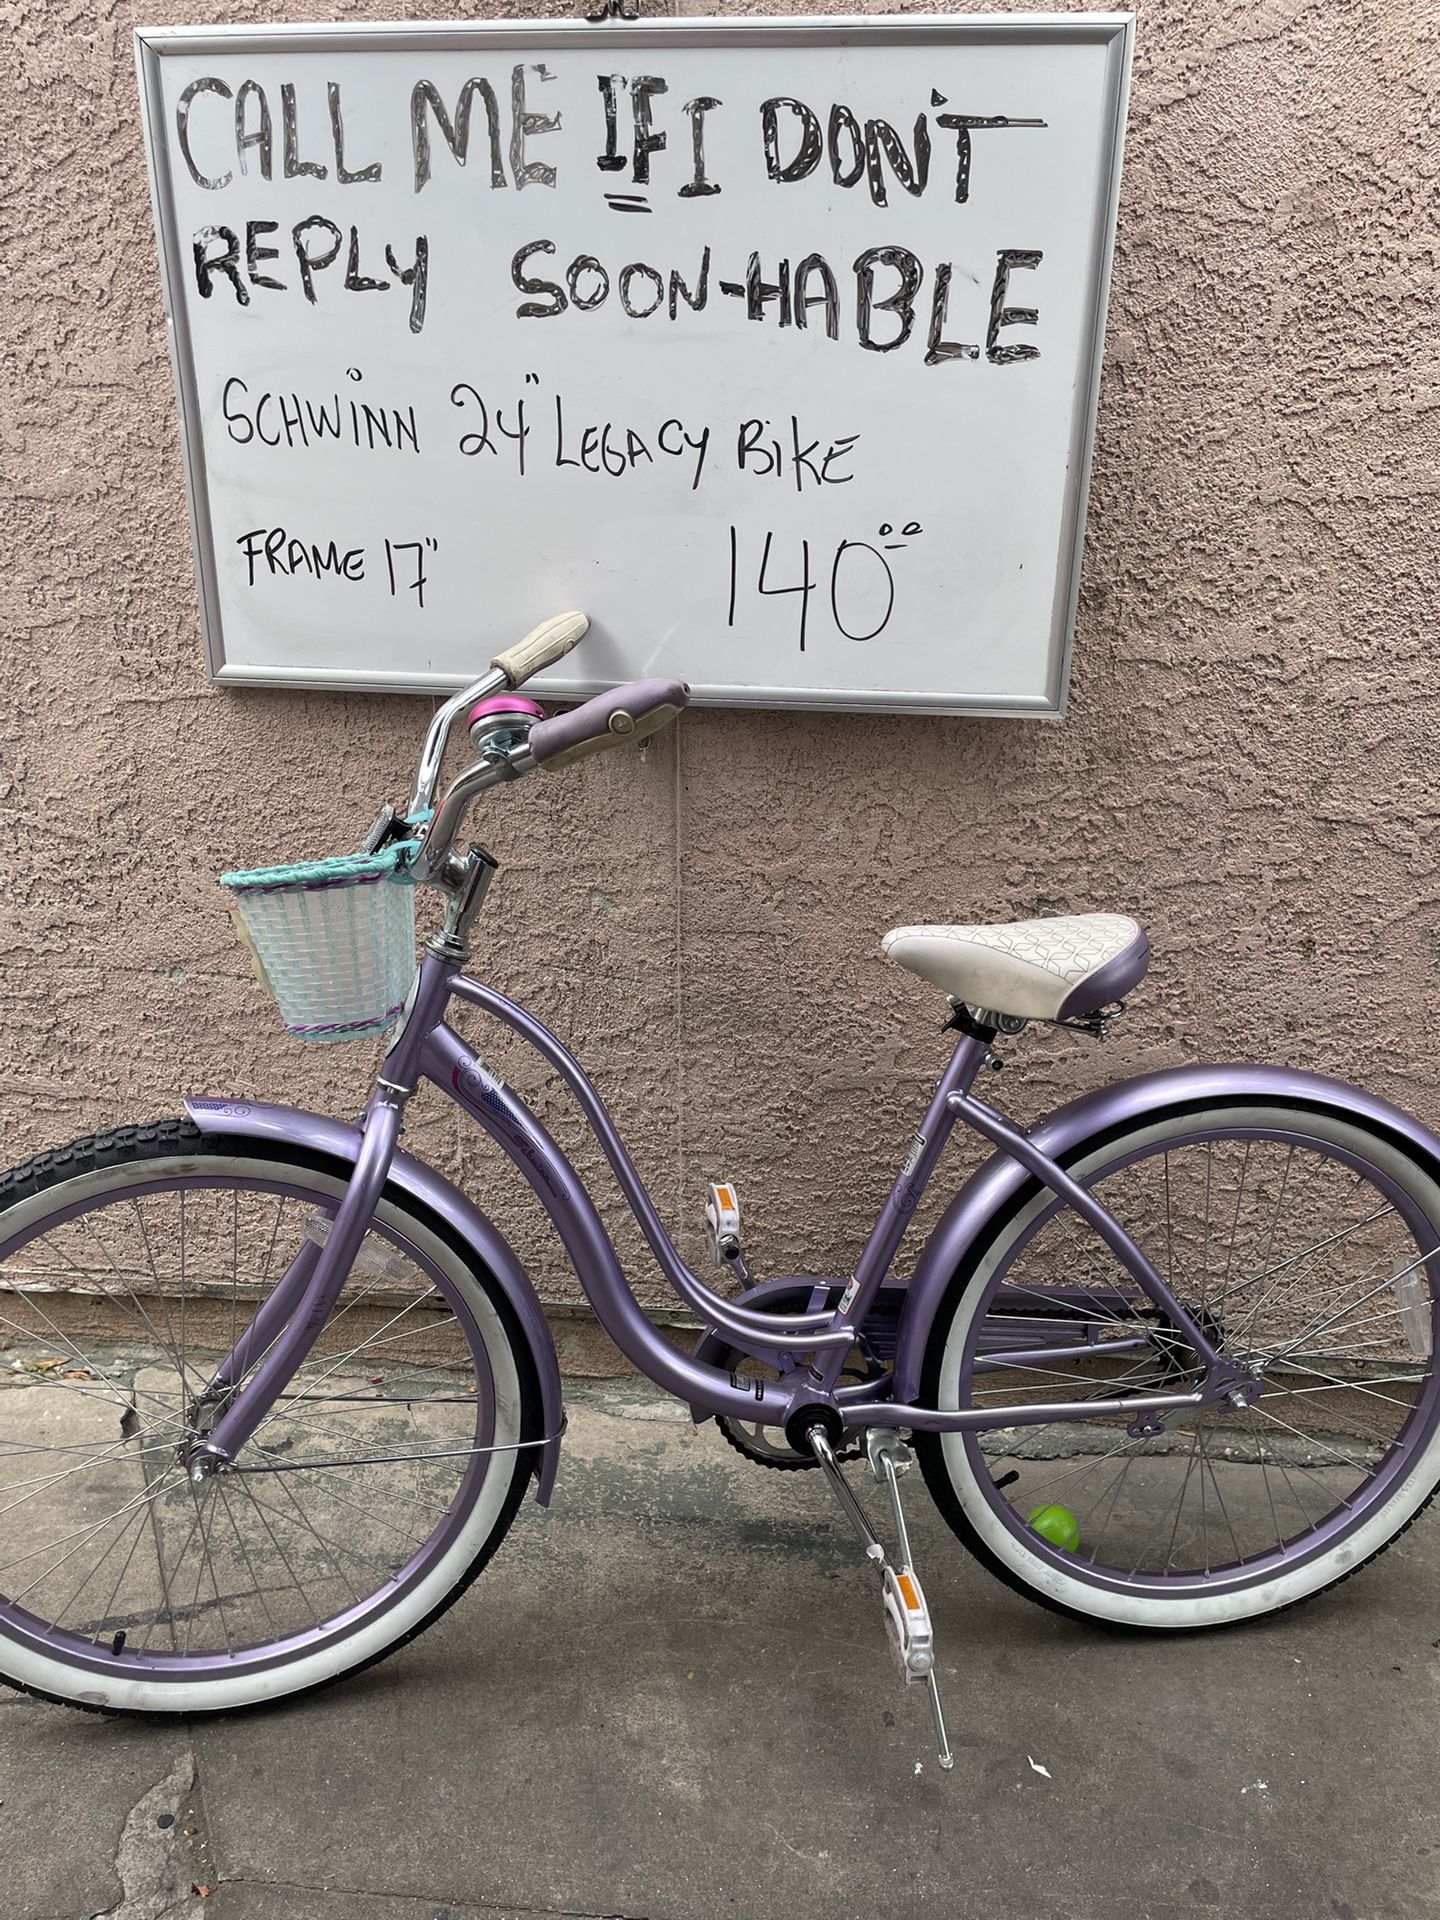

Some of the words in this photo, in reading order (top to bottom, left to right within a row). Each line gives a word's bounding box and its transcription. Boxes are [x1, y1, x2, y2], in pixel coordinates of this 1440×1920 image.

[176, 77, 382, 190] CALL
[411, 64, 562, 192] ME
[597, 74, 668, 185] IF
[677, 96, 723, 197] I
[760, 88, 1048, 207] DON'T
[193, 215, 428, 333] REPLY
[451, 373, 540, 476] 24"
[555, 395, 709, 490] LEGACY
[237, 527, 364, 586] FRAME
[385, 537, 438, 608] 17"
